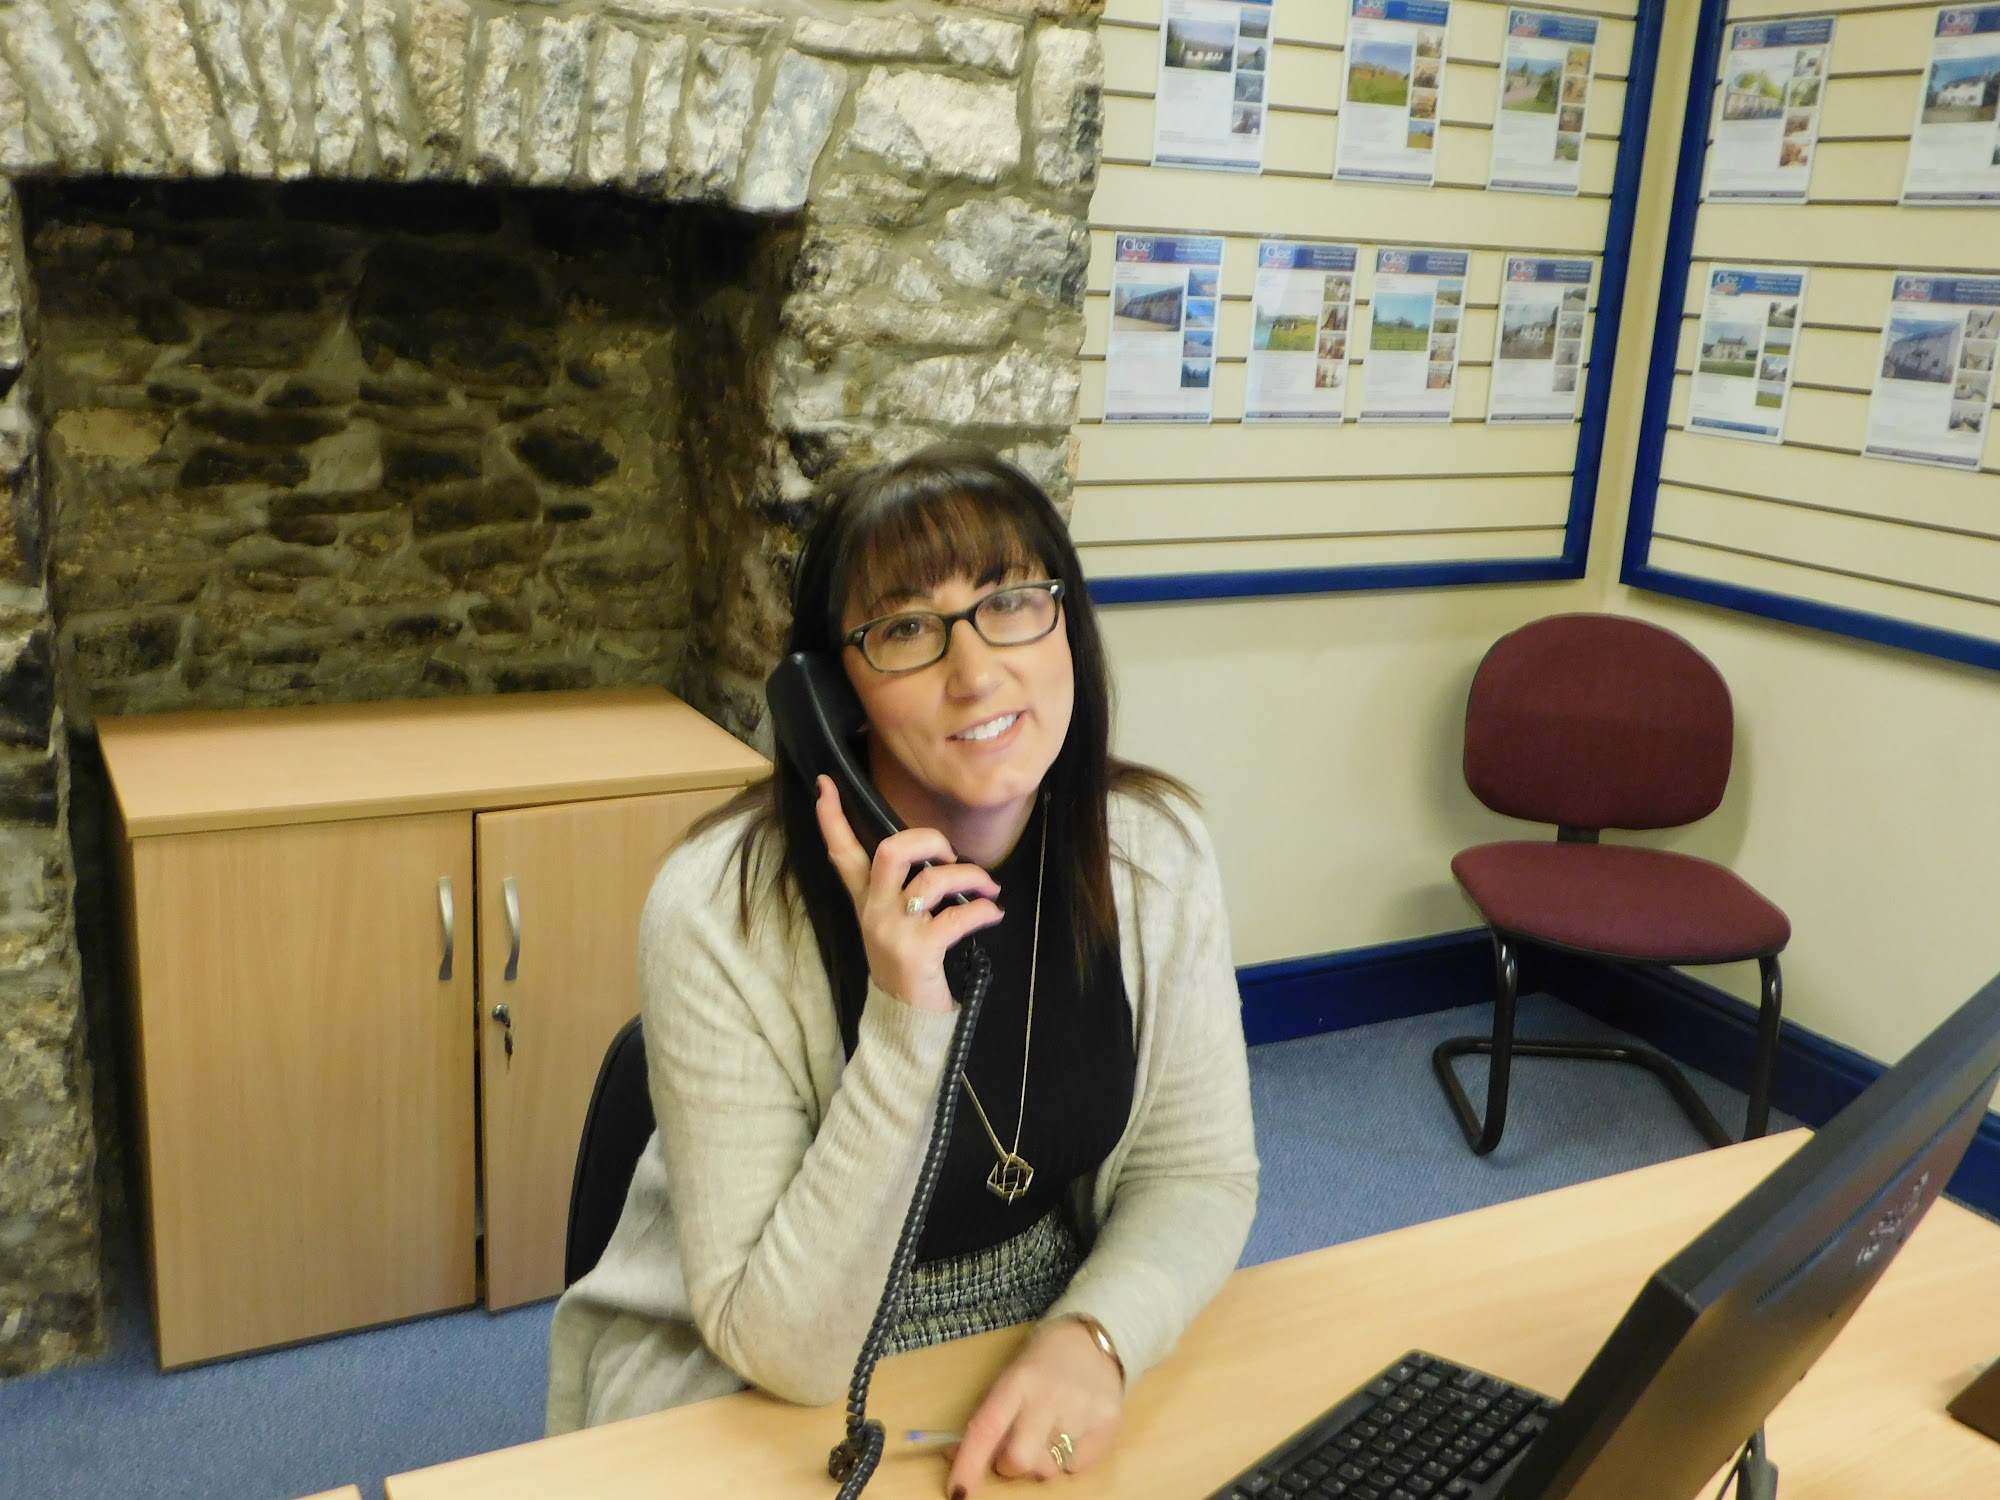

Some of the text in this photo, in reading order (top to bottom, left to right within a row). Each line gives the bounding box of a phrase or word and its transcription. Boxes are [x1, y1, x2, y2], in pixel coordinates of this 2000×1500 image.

[1123, 238, 1151, 252] Clee
[1265, 246, 1291, 258] Clee
[1382, 251, 1406, 264] Clee
